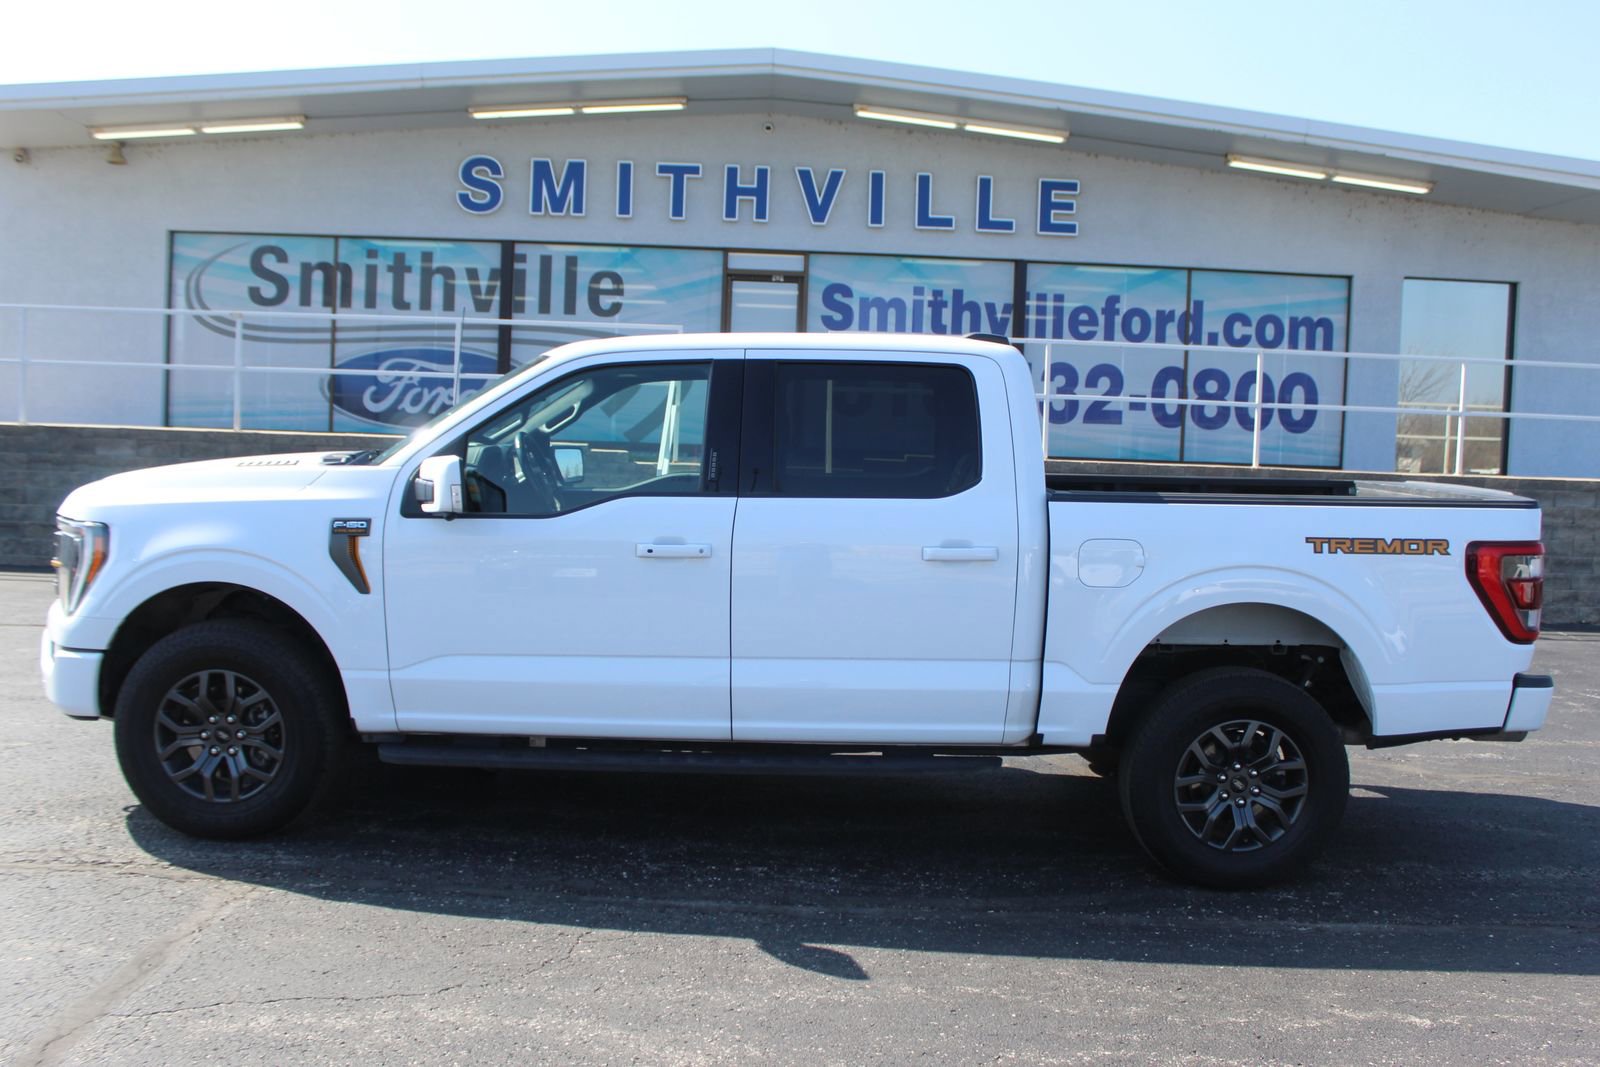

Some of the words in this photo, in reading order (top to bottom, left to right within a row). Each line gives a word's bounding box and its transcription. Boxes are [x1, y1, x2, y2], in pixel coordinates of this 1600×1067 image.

[455, 155, 1081, 237] SMITHVILLE
[247, 244, 626, 318] Smithville
[1027, 360, 1319, 434] 32-0800
[1305, 537, 1450, 555] TREMOR
